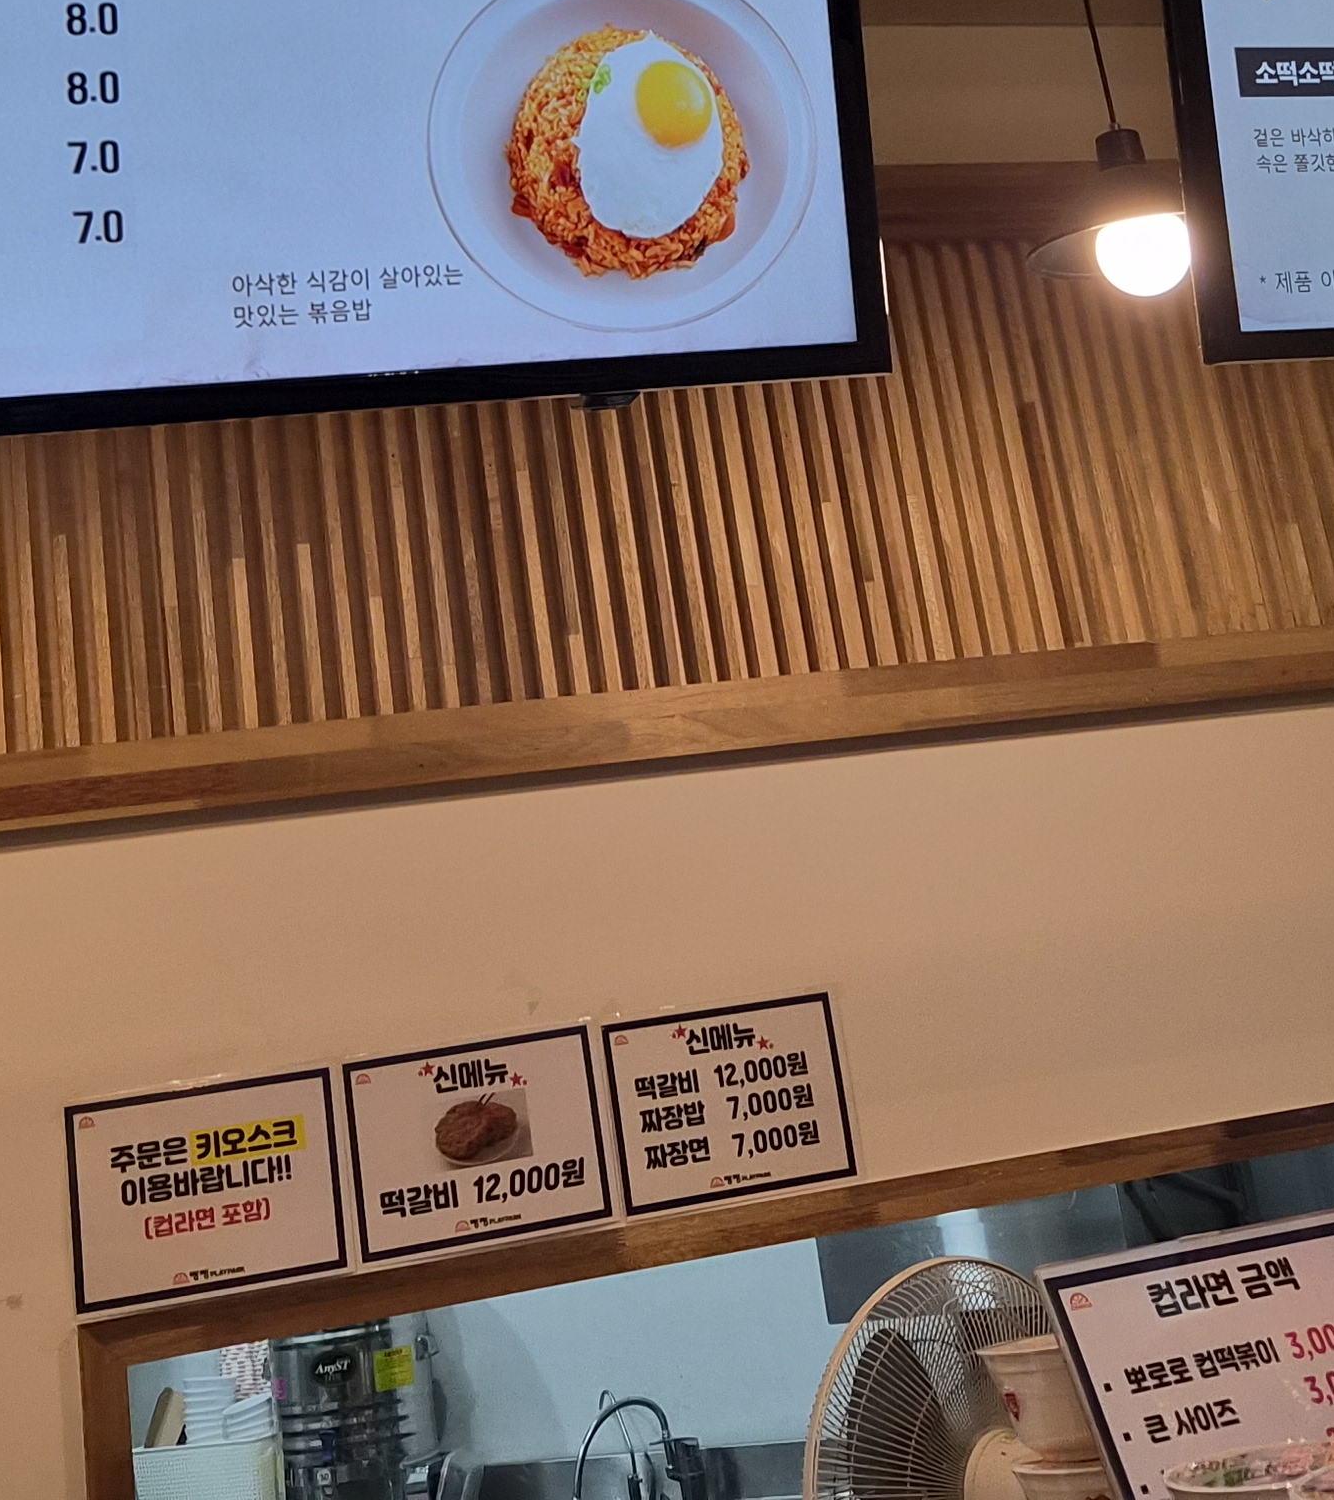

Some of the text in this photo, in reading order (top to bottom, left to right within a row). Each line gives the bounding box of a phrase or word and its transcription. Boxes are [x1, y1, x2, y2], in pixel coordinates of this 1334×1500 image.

[67, 3, 117, 35] 8.0
[68, 71, 119, 104] 8.0
[1254, 129, 1284, 147] 겉은
[68, 141, 119, 174] 7.0
[1257, 155, 1287, 173] 속은
[73, 210, 123, 243] 7.0
[233, 265, 463, 297] 아삭한 식감이 살아있는
[1275, 271, 1312, 293] 제품
[234, 299, 371, 328] 맛있는 볶음밥
[685, 1023, 756, 1056] 신메뉴
[433, 1059, 509, 1094] 신메뉴
[633, 1051, 809, 1100] 떡갈비 12,000원
[639, 1083, 815, 1135] 짜장밥 7,000원
[109, 1118, 299, 1174] 주문은 키오스크
[644, 1120, 821, 1170] 짜장면 7,000원
[120, 1155, 293, 1207] 이용바랍니다!!
[380, 1156, 587, 1219] 떡갈비 12,000원
[143, 1197, 272, 1241] (컵라면 포함)
[1145, 1257, 1301, 1319] 컵라면 금액
[1122, 1357, 1193, 1396] 뽀로로
[1194, 1337, 1280, 1379] 컵떡볶이
[1143, 1414, 1171, 1444] 큰
[1174, 1399, 1241, 1437] 사이즈
